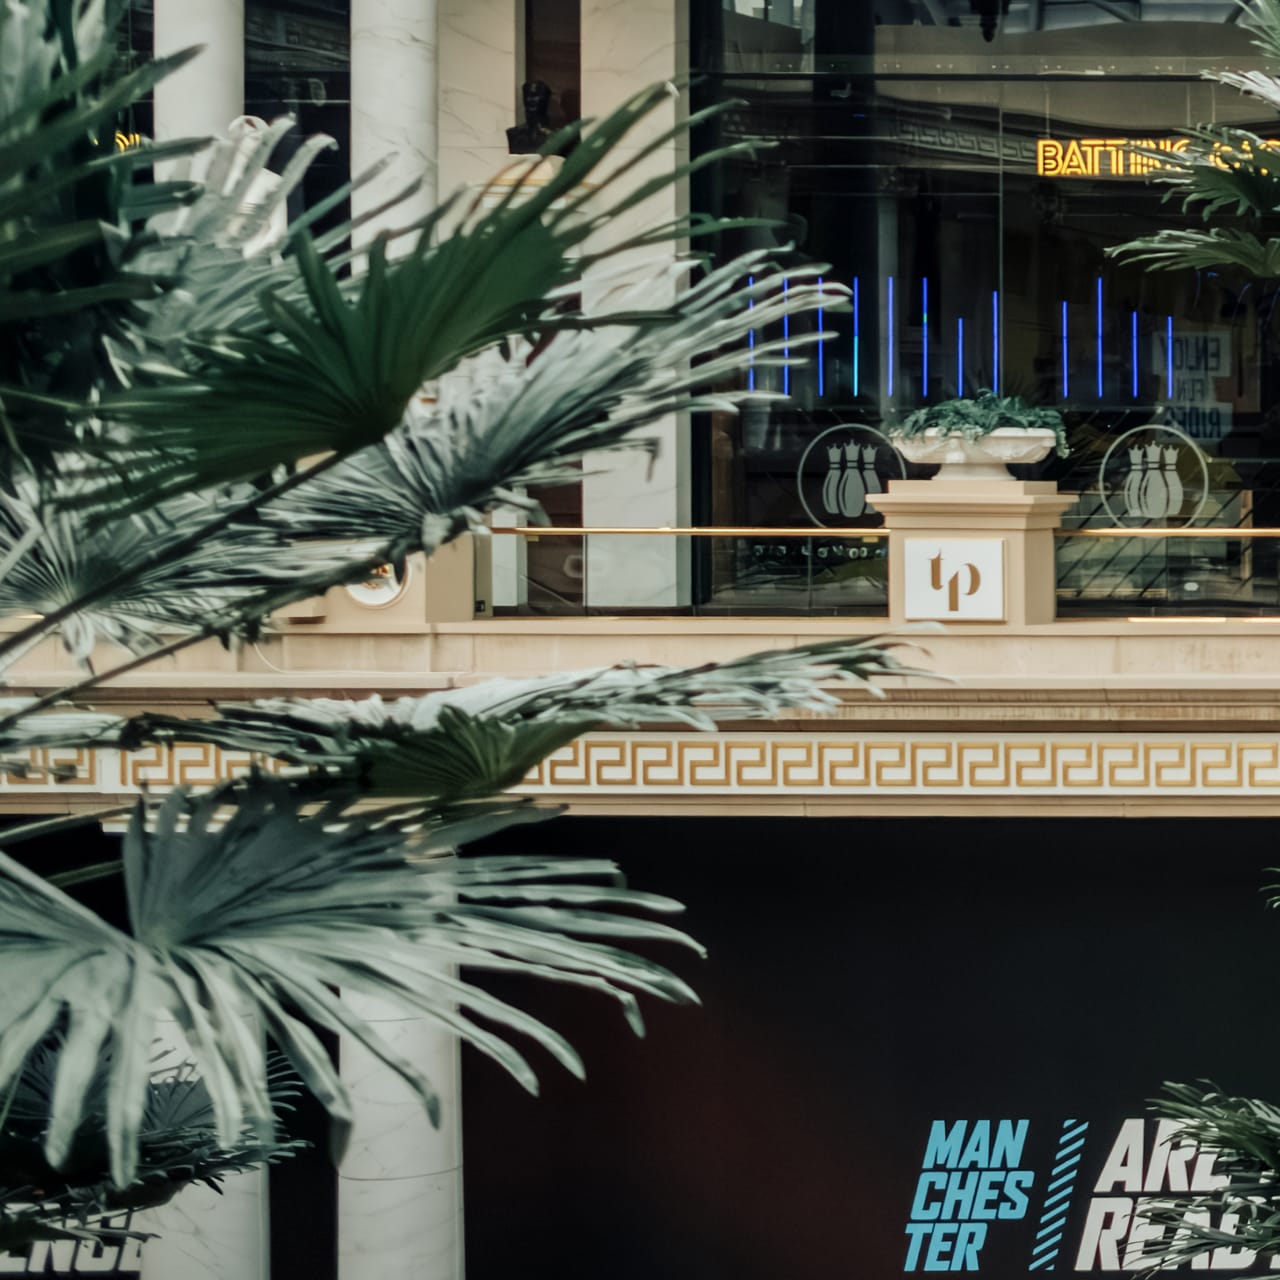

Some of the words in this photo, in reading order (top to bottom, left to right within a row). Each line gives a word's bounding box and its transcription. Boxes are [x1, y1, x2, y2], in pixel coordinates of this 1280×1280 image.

[922, 1119, 1029, 1169] MAN
[910, 1170, 1034, 1220] CHES
[904, 1223, 987, 1271] TER
